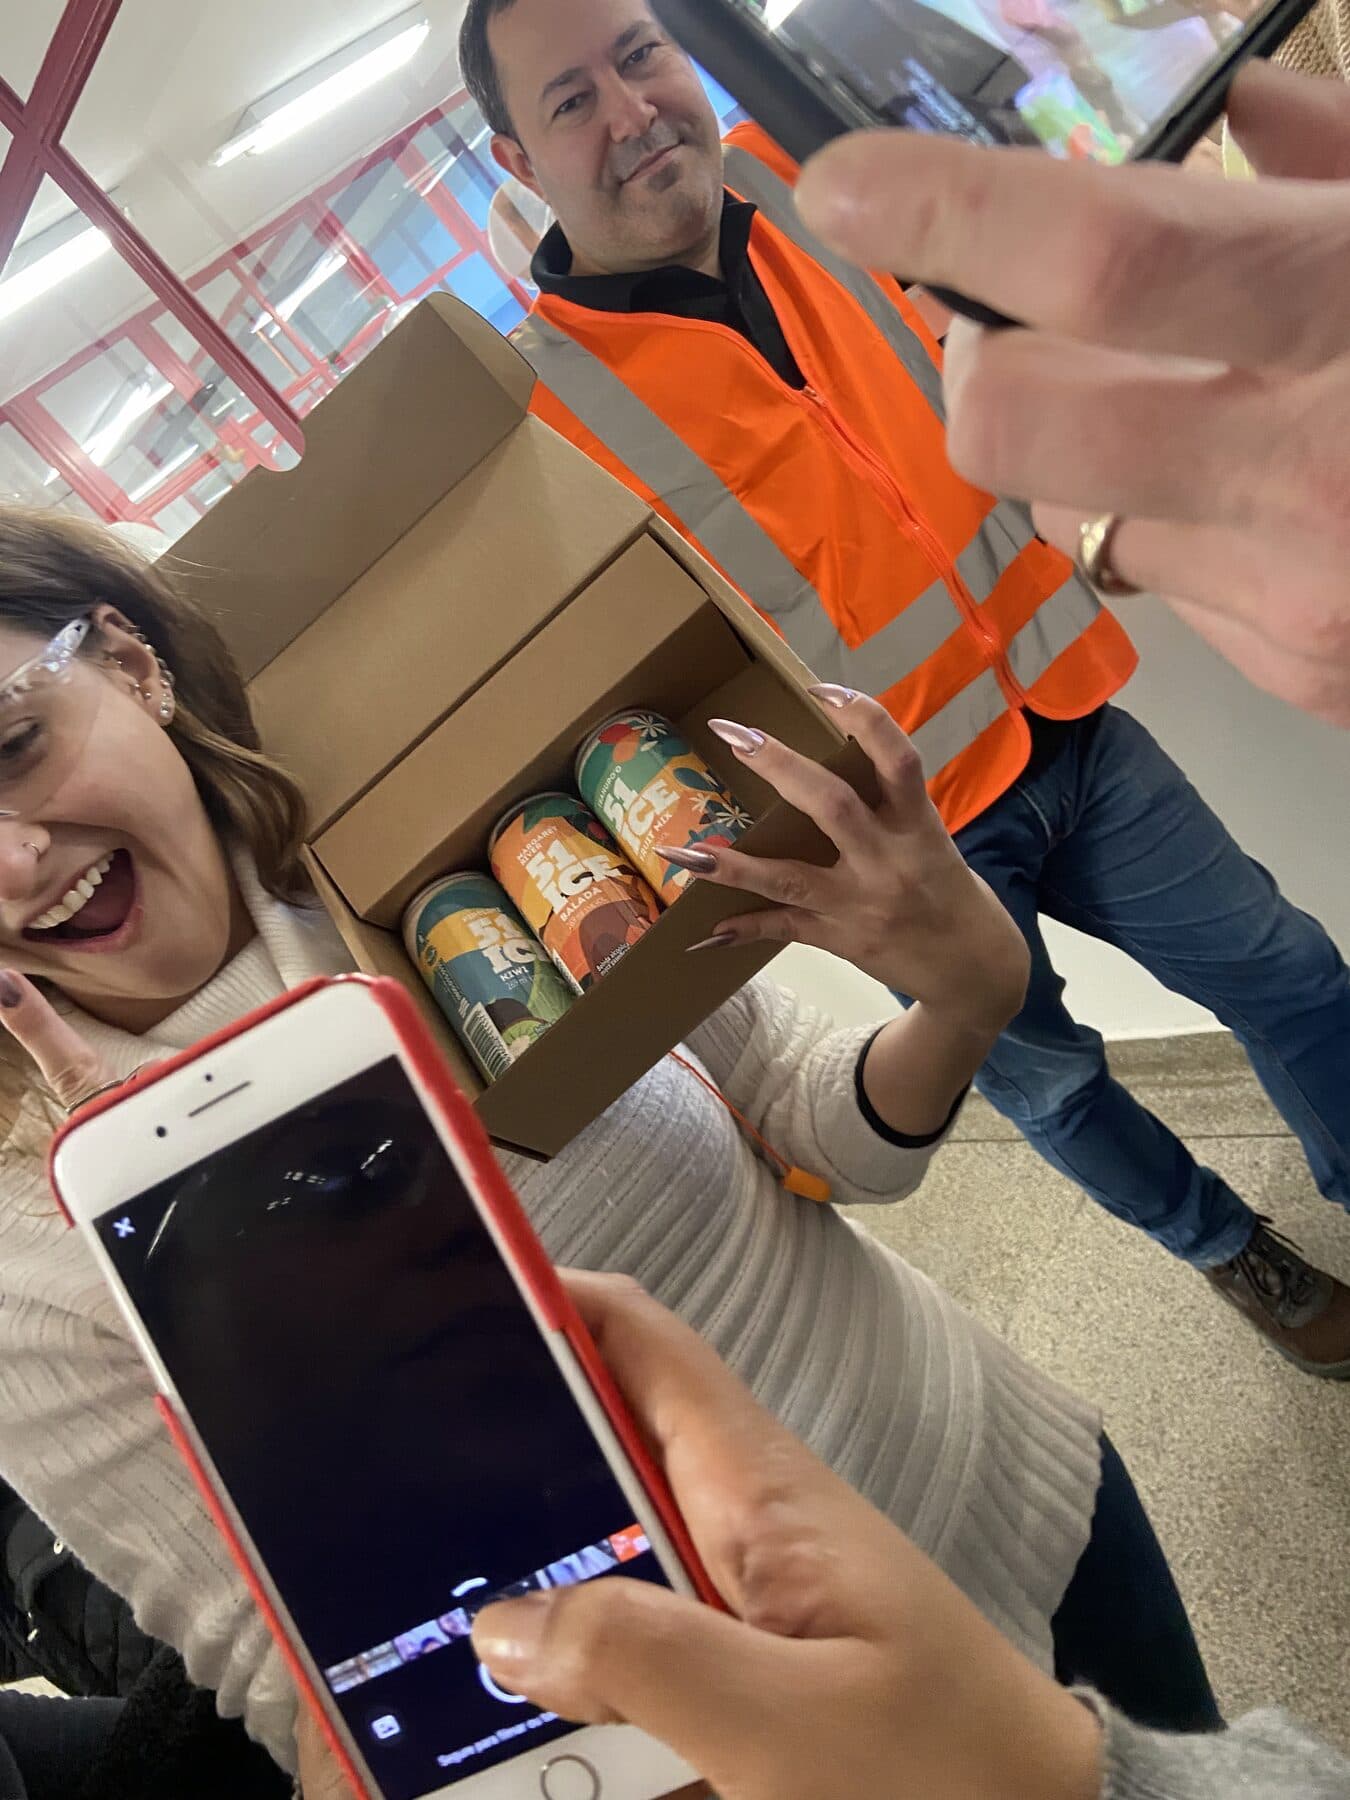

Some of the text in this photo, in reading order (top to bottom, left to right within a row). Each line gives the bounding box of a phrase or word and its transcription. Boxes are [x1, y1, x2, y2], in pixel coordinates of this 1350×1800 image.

[603, 777, 639, 834] 51
[620, 778, 681, 858] ICE
[516, 825, 559, 862] MARGARET
[519, 843, 543, 867] RIVER
[638, 812, 673, 862] FRUIT MIX
[525, 839, 578, 891] 51
[536, 854, 623, 915] ICE
[559, 886, 603, 923] BALADA
[467, 912, 524, 950] 51
[500, 965, 529, 983] KIWI
